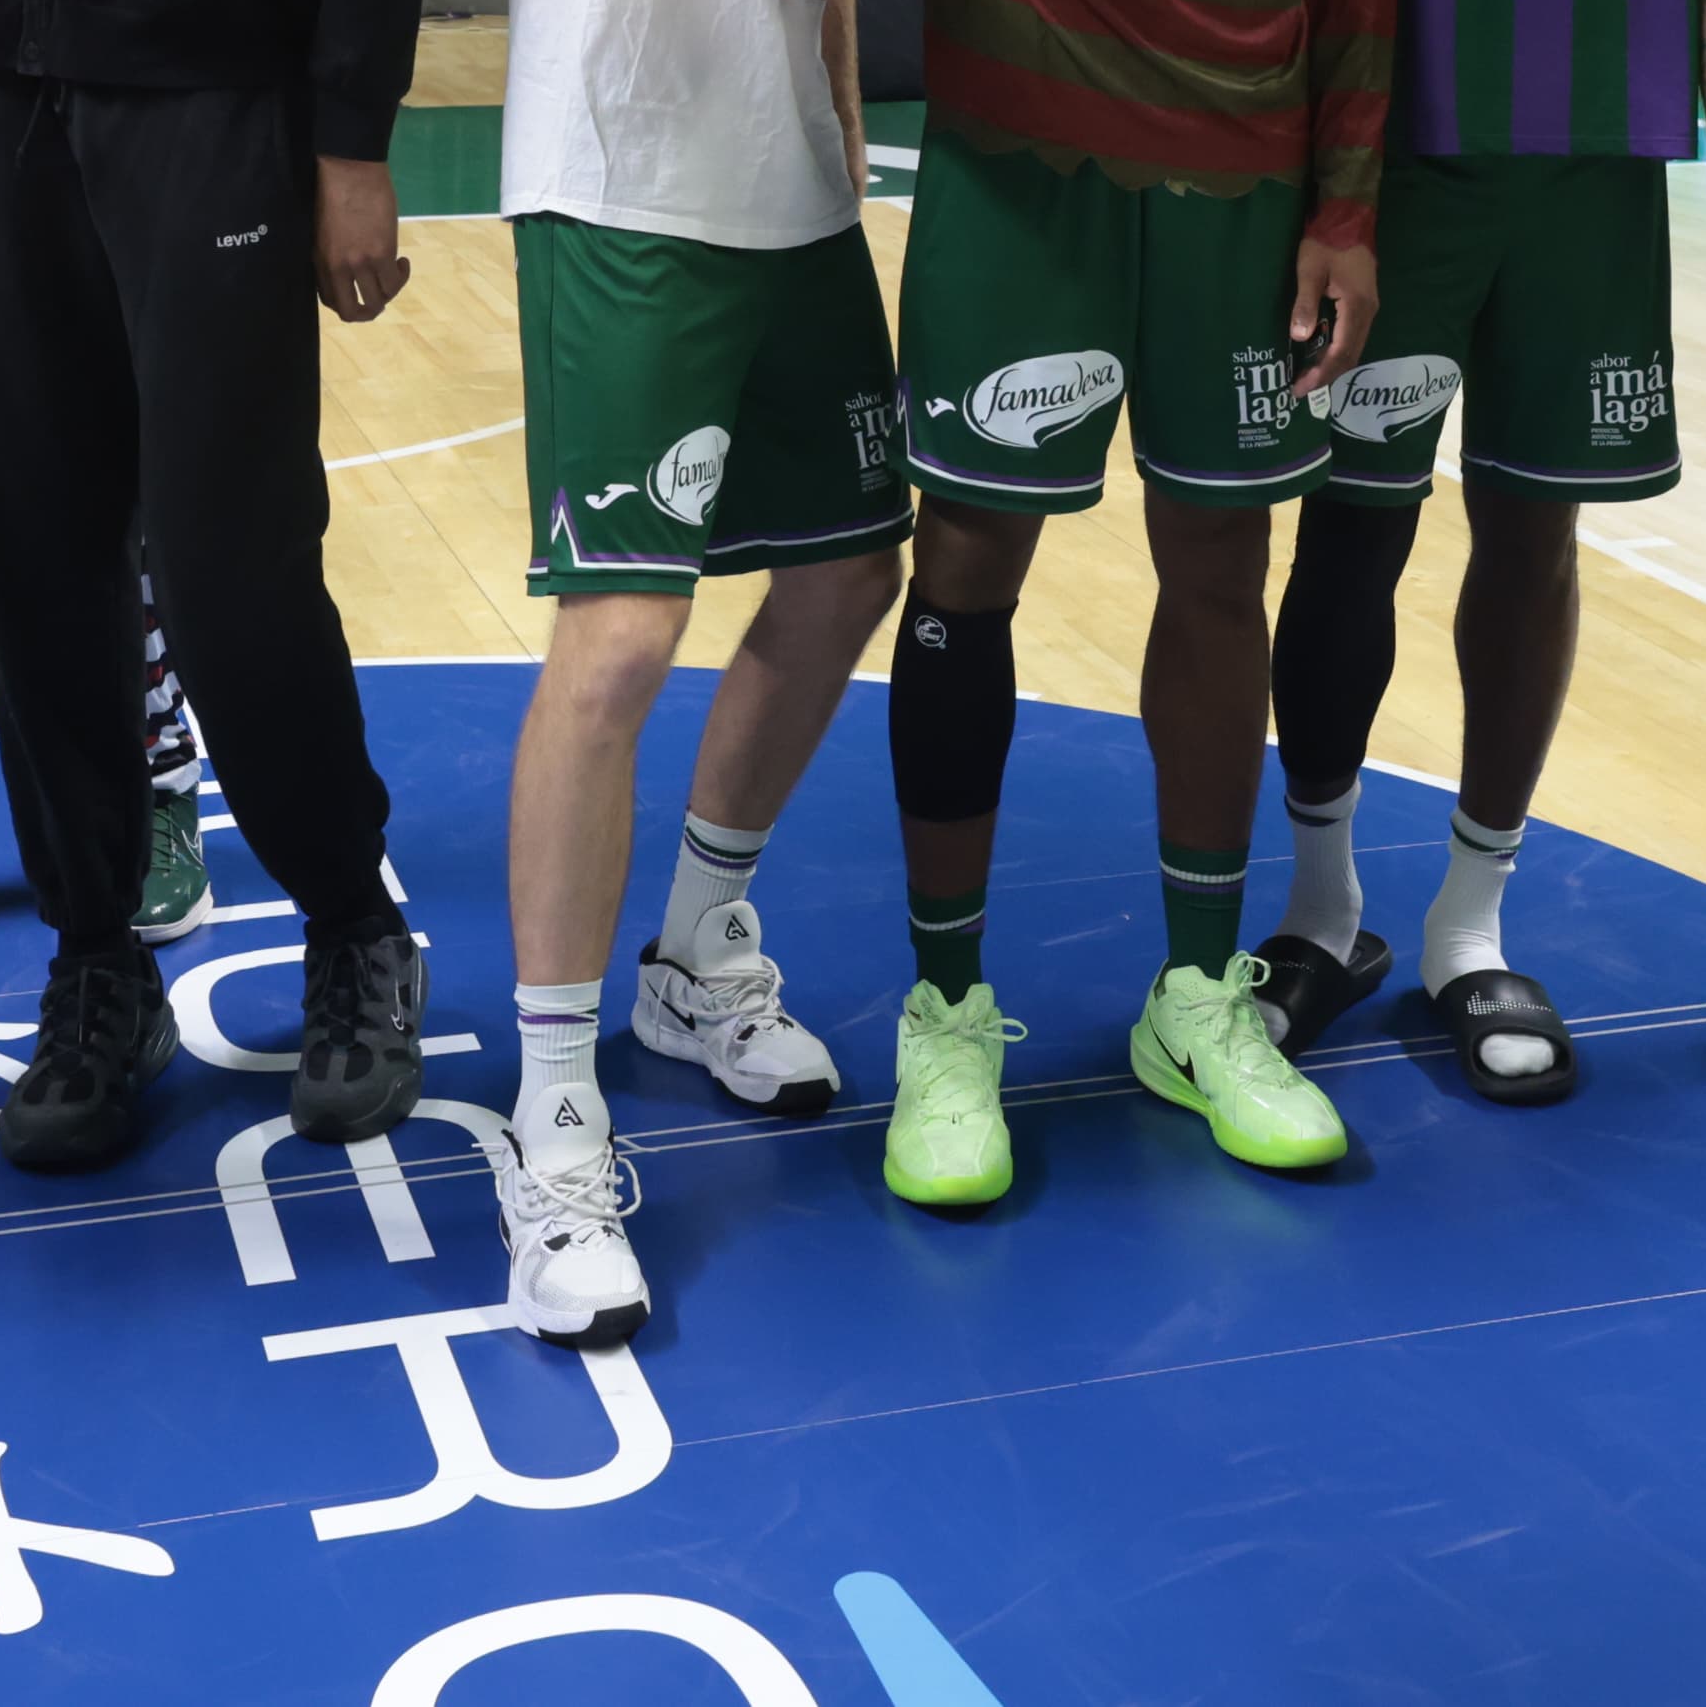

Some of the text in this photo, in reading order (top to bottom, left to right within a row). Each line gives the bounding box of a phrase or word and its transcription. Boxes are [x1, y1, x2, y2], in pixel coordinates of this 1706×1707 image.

[1232, 346, 1275, 364] sabor
[1234, 365, 1248, 382] a
[1590, 352, 1632, 370] sabor
[1590, 349, 1668, 397] a má
[979, 360, 1116, 425] famadesa
[1333, 362, 1458, 418] famadesa
[1590, 387, 1669, 433] laga
[849, 410, 862, 429] a
[854, 430, 887, 471] la
